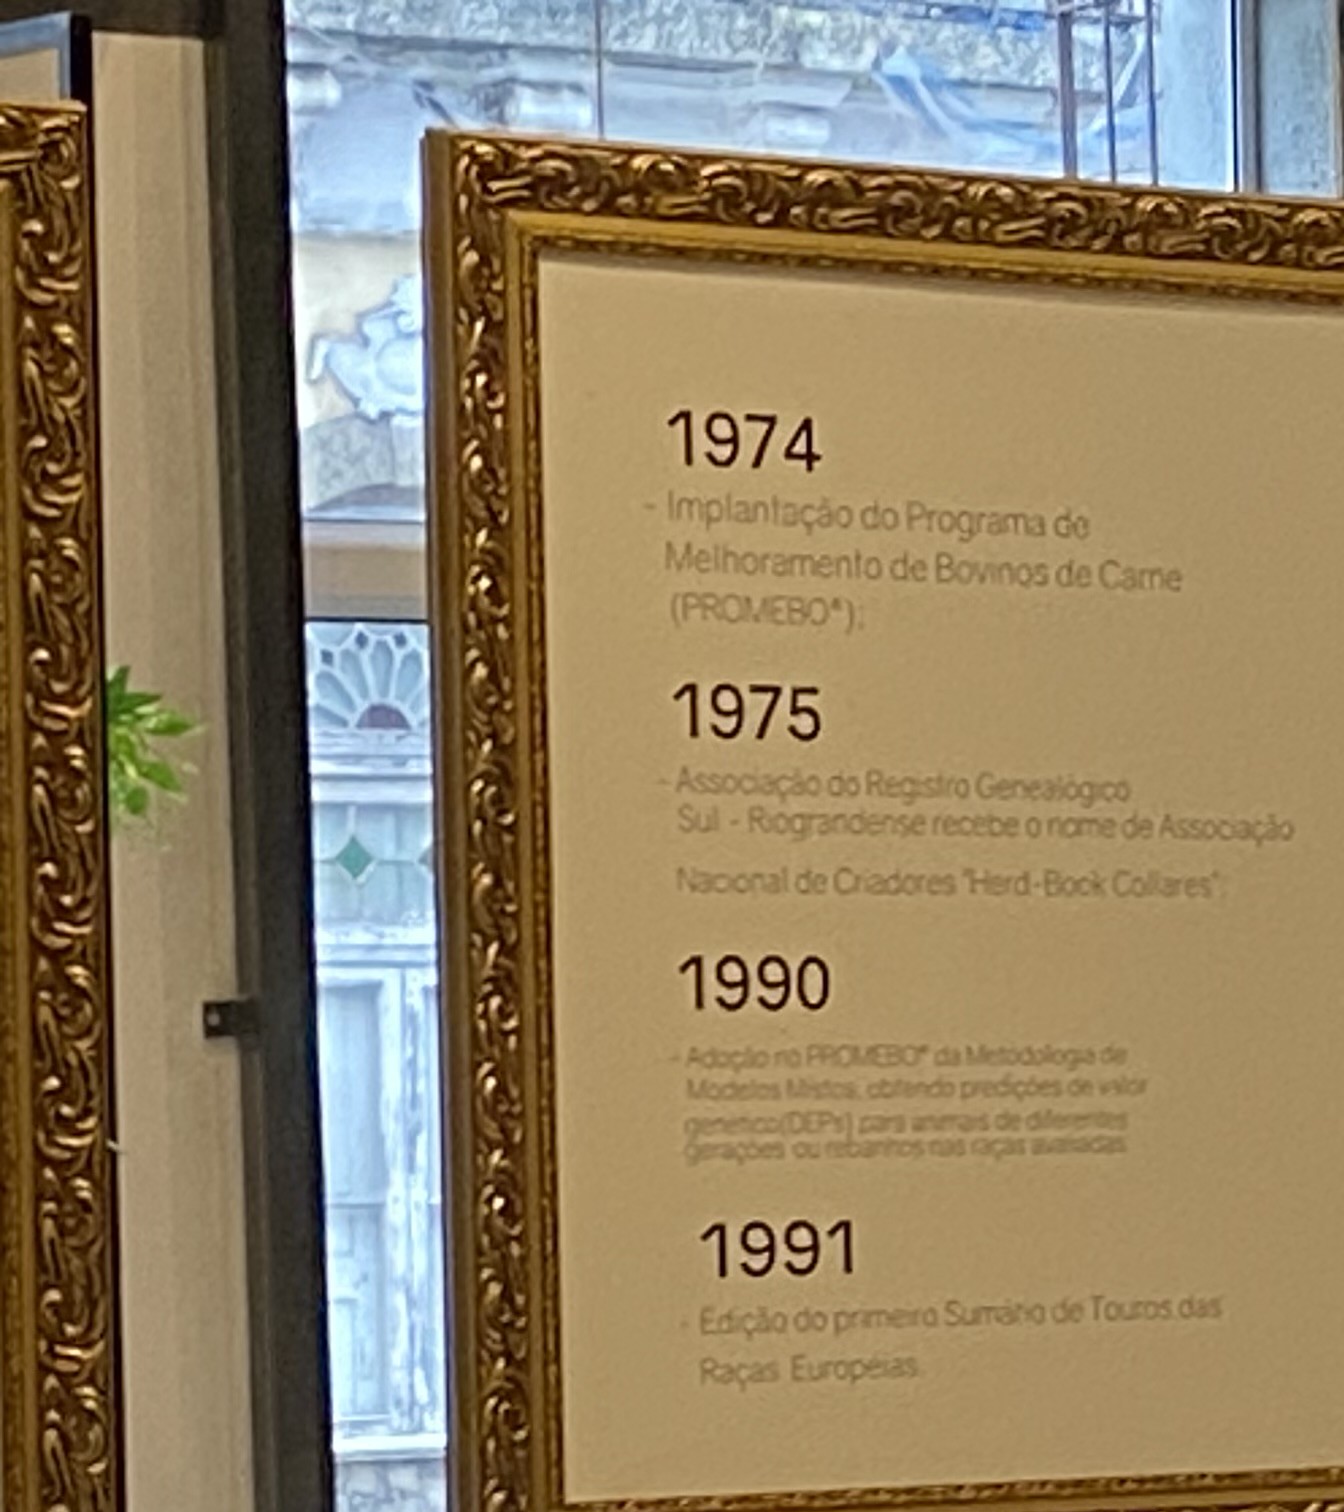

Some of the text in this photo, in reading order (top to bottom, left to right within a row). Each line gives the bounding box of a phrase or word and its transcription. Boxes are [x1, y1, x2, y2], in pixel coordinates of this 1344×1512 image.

[666, 409, 823, 473] 1974
[667, 490, 1090, 543] Implantação do Programa de
[664, 540, 1183, 592] Melhoramento de Bovinos de Carne
[671, 681, 822, 741] 1975
[676, 765, 821, 804] Associação
[826, 773, 861, 797] do
[865, 768, 970, 805] Registro
[677, 803, 720, 833] Sul
[748, 804, 926, 842] Riograndense
[931, 812, 1020, 839] recebe
[1025, 816, 1041, 838] o
[1047, 817, 1117, 839] nome
[1121, 811, 1154, 840] de
[1159, 812, 1295, 848] Associação
[676, 866, 789, 895] Nacional
[795, 867, 828, 894] de
[833, 867, 957, 895] Criadores
[678, 954, 830, 1012] 1990
[700, 1219, 857, 1278] 1991
[699, 1295, 1224, 1341] Edição do primeiro Sumário de Touros das
[699, 1357, 779, 1393] Raças
